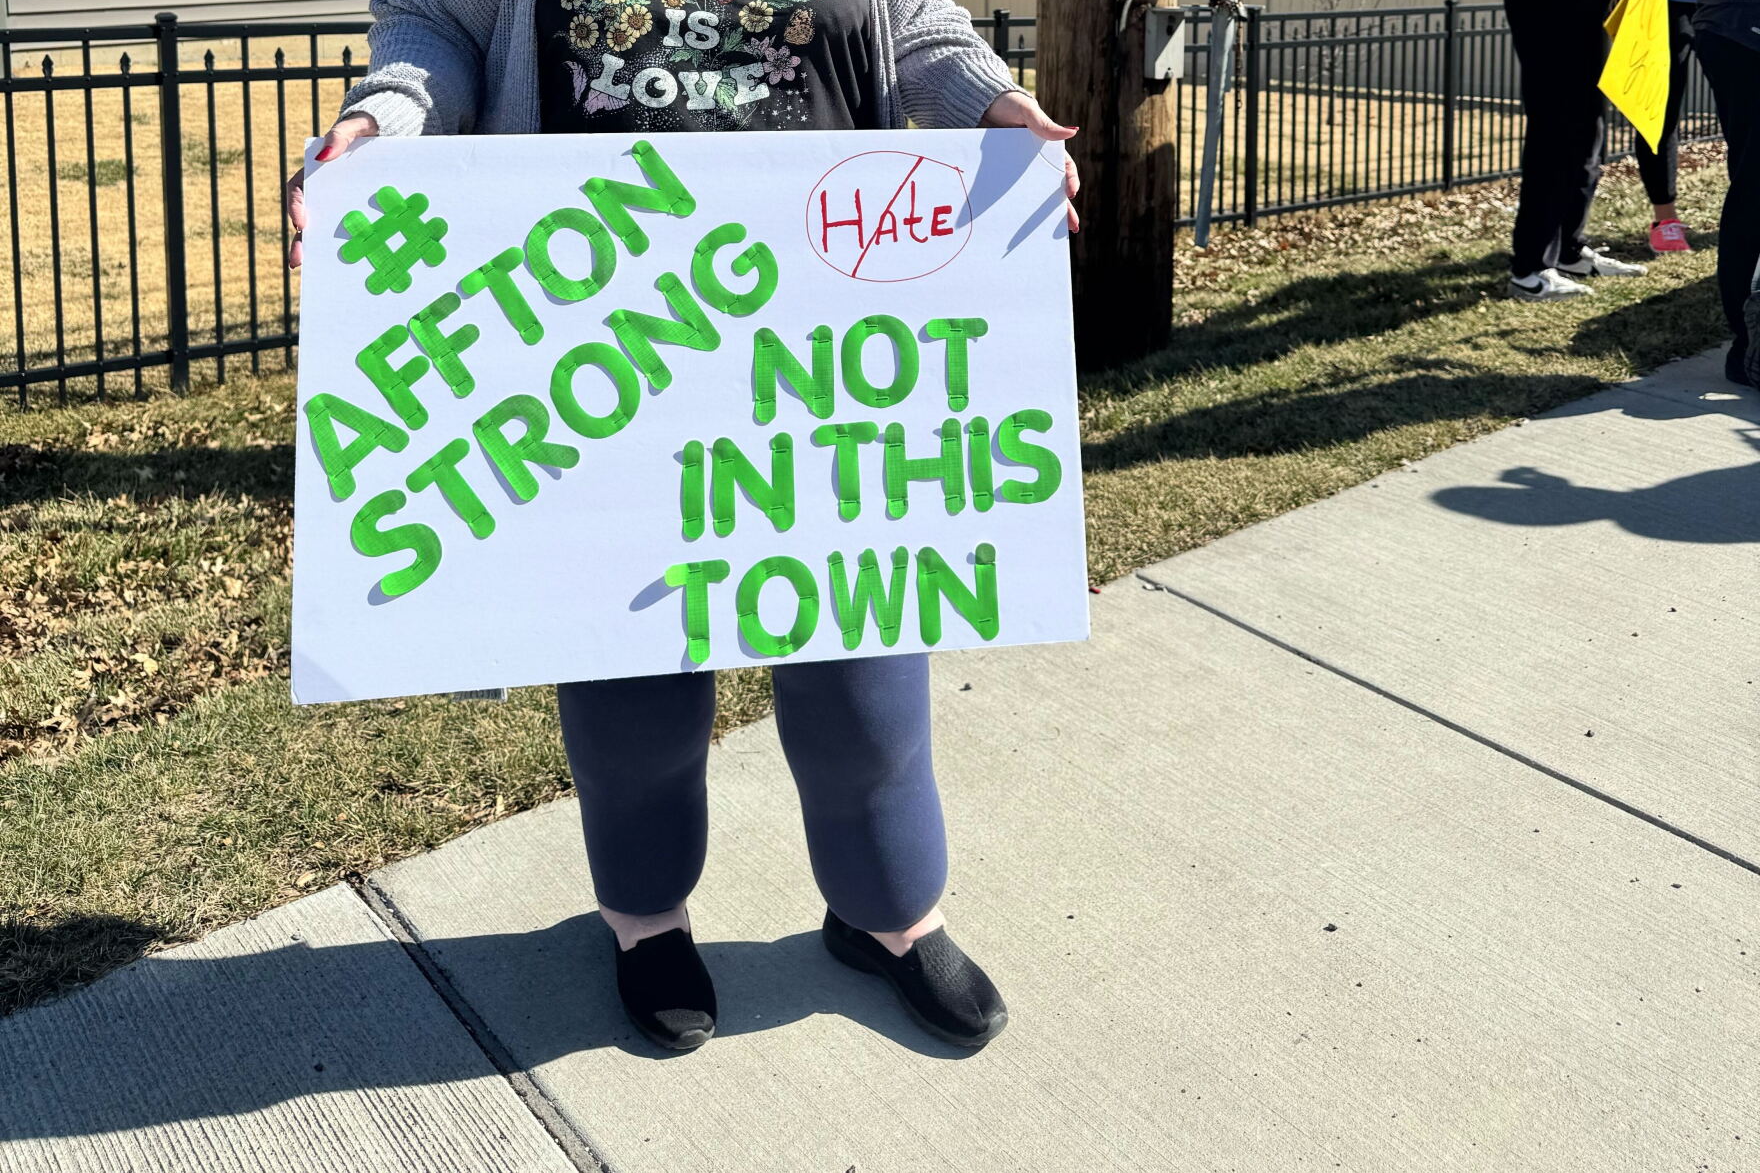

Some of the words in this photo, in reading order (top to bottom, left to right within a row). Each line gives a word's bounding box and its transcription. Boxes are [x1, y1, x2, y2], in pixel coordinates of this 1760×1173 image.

[589, 53, 770, 111] LOVE
[662, 8, 721, 50] IS
[304, 140, 697, 501] AFFTON
[753, 314, 989, 425] NOT
[350, 223, 780, 597] STRONG
[681, 433, 796, 541] IN
[814, 409, 1063, 522] THIS
[664, 542, 1000, 665] TOWN
